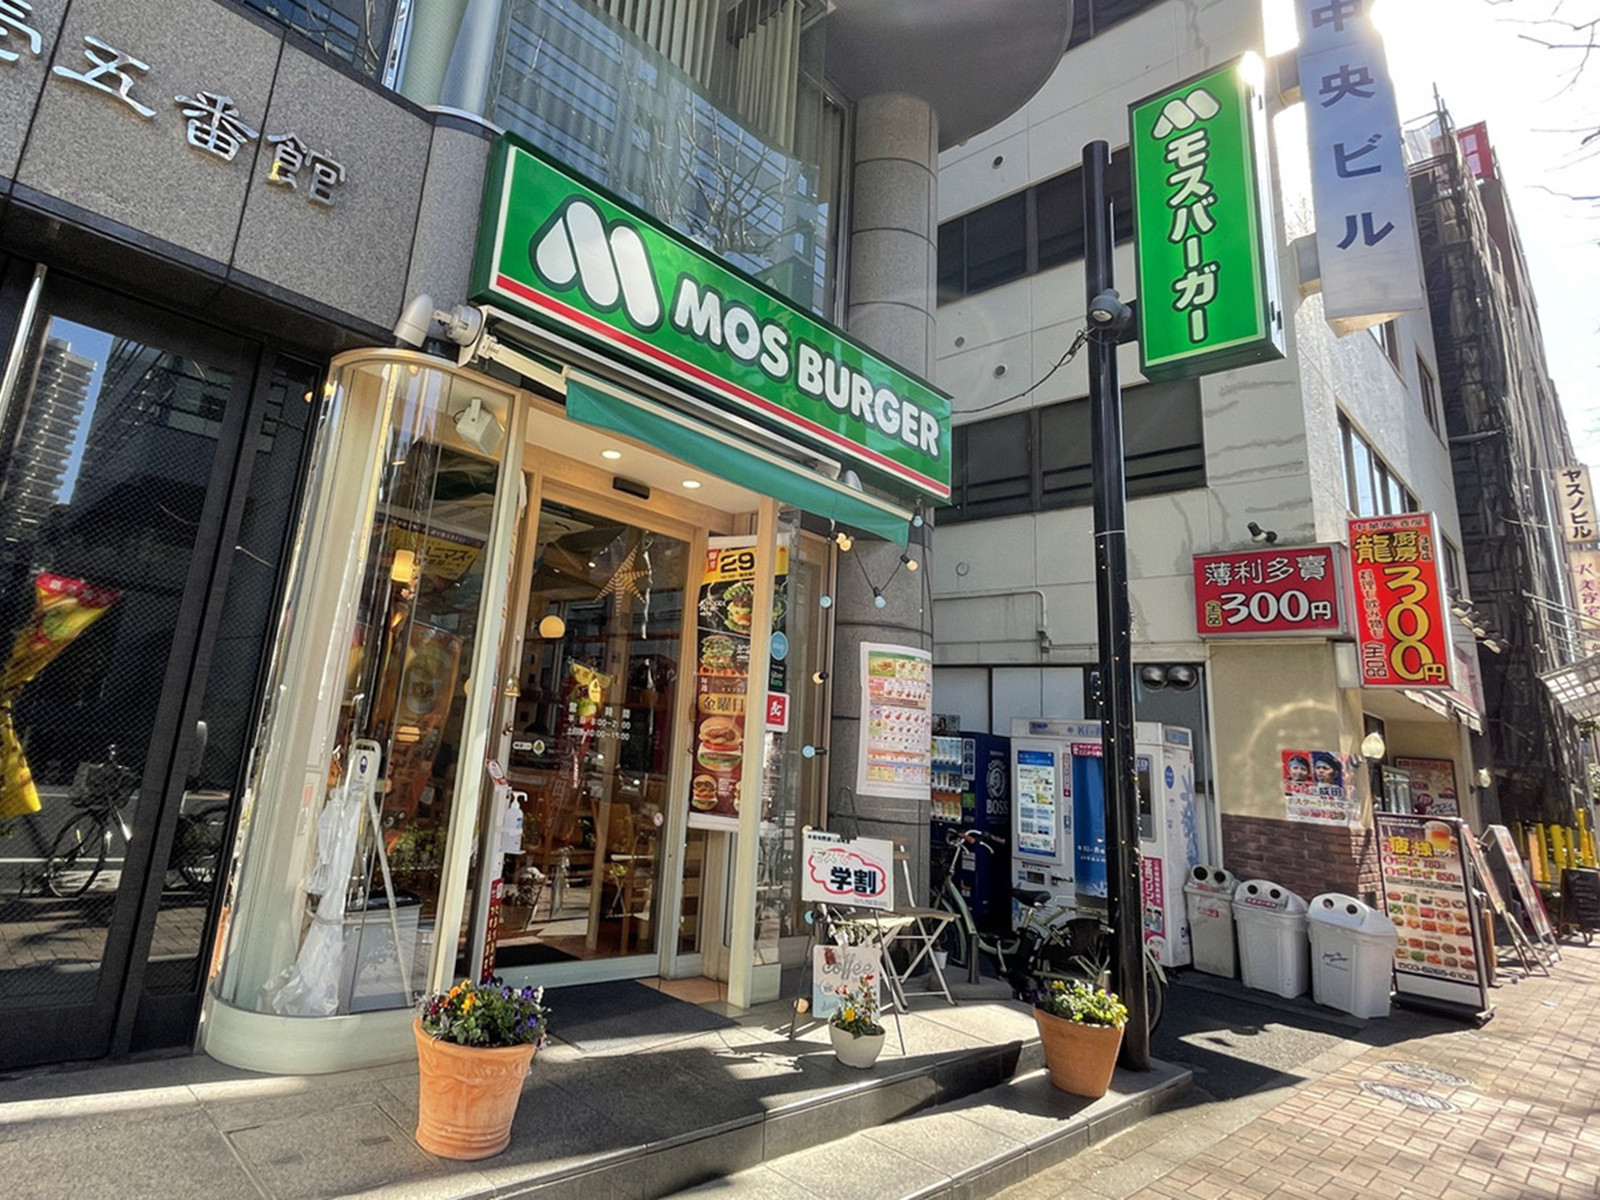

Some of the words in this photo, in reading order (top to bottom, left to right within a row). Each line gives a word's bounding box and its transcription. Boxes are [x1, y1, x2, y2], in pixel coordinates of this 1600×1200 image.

[1311, 0, 1395, 250] 中央ビル
[1165, 129, 1219, 343] モスバーガー
[674, 277, 790, 378] MOS
[799, 345, 941, 458] BURGER
[1562, 469, 1592, 539] ヤスノビル
[720, 551, 755, 573] 29
[1219, 590, 1332, 625] 300円
[830, 866, 877, 895] 学割
